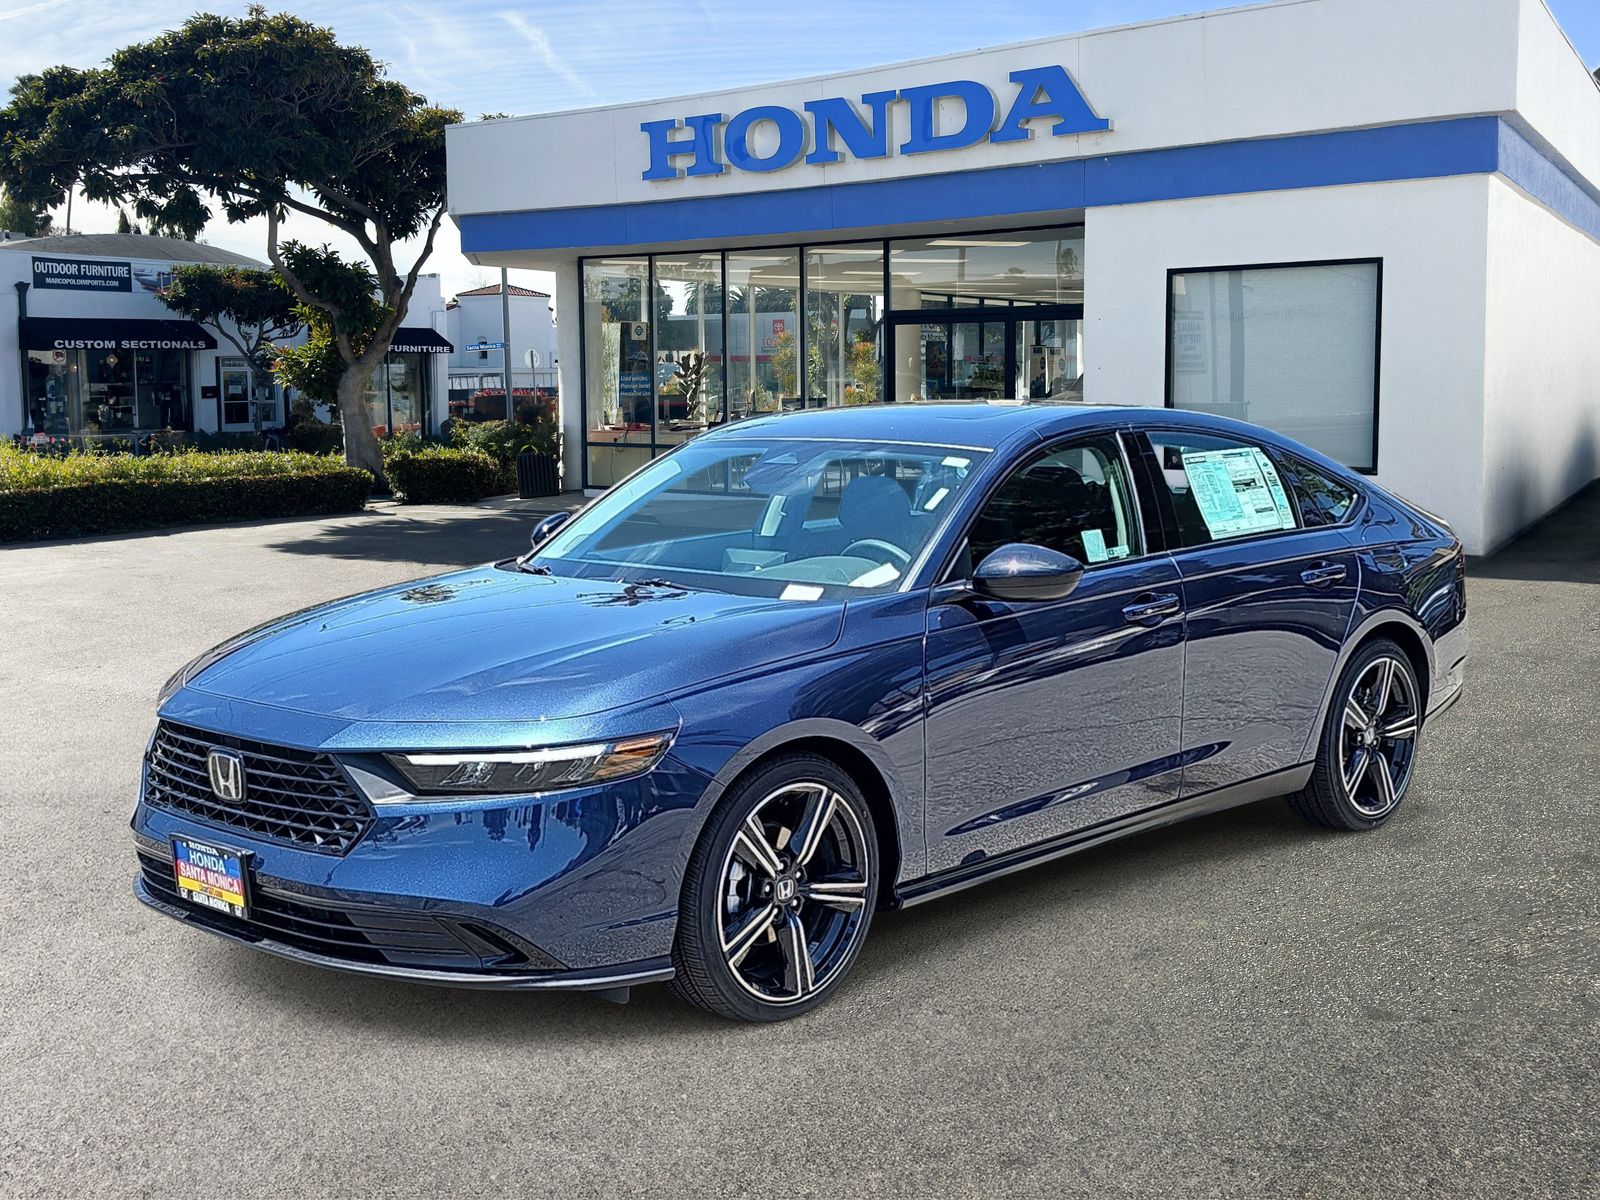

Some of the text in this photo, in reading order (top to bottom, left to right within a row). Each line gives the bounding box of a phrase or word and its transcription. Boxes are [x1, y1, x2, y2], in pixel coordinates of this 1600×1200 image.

[640, 64, 1111, 182] HONDA
[34, 261, 129, 277] OUTDOOR FURNITURE
[45, 277, 119, 286] MARCOPOLOIMPORTS.COM
[54, 339, 206, 349] CUSTOM SECTIONALS
[388, 344, 450, 353] FURNITURE
[188, 841, 219, 856] HONDA
[189, 849, 226, 874] HONDA
[180, 862, 207, 883] SANTA
[206, 870, 240, 894] MONICA
[192, 892, 231, 913] SANTA MONICA
